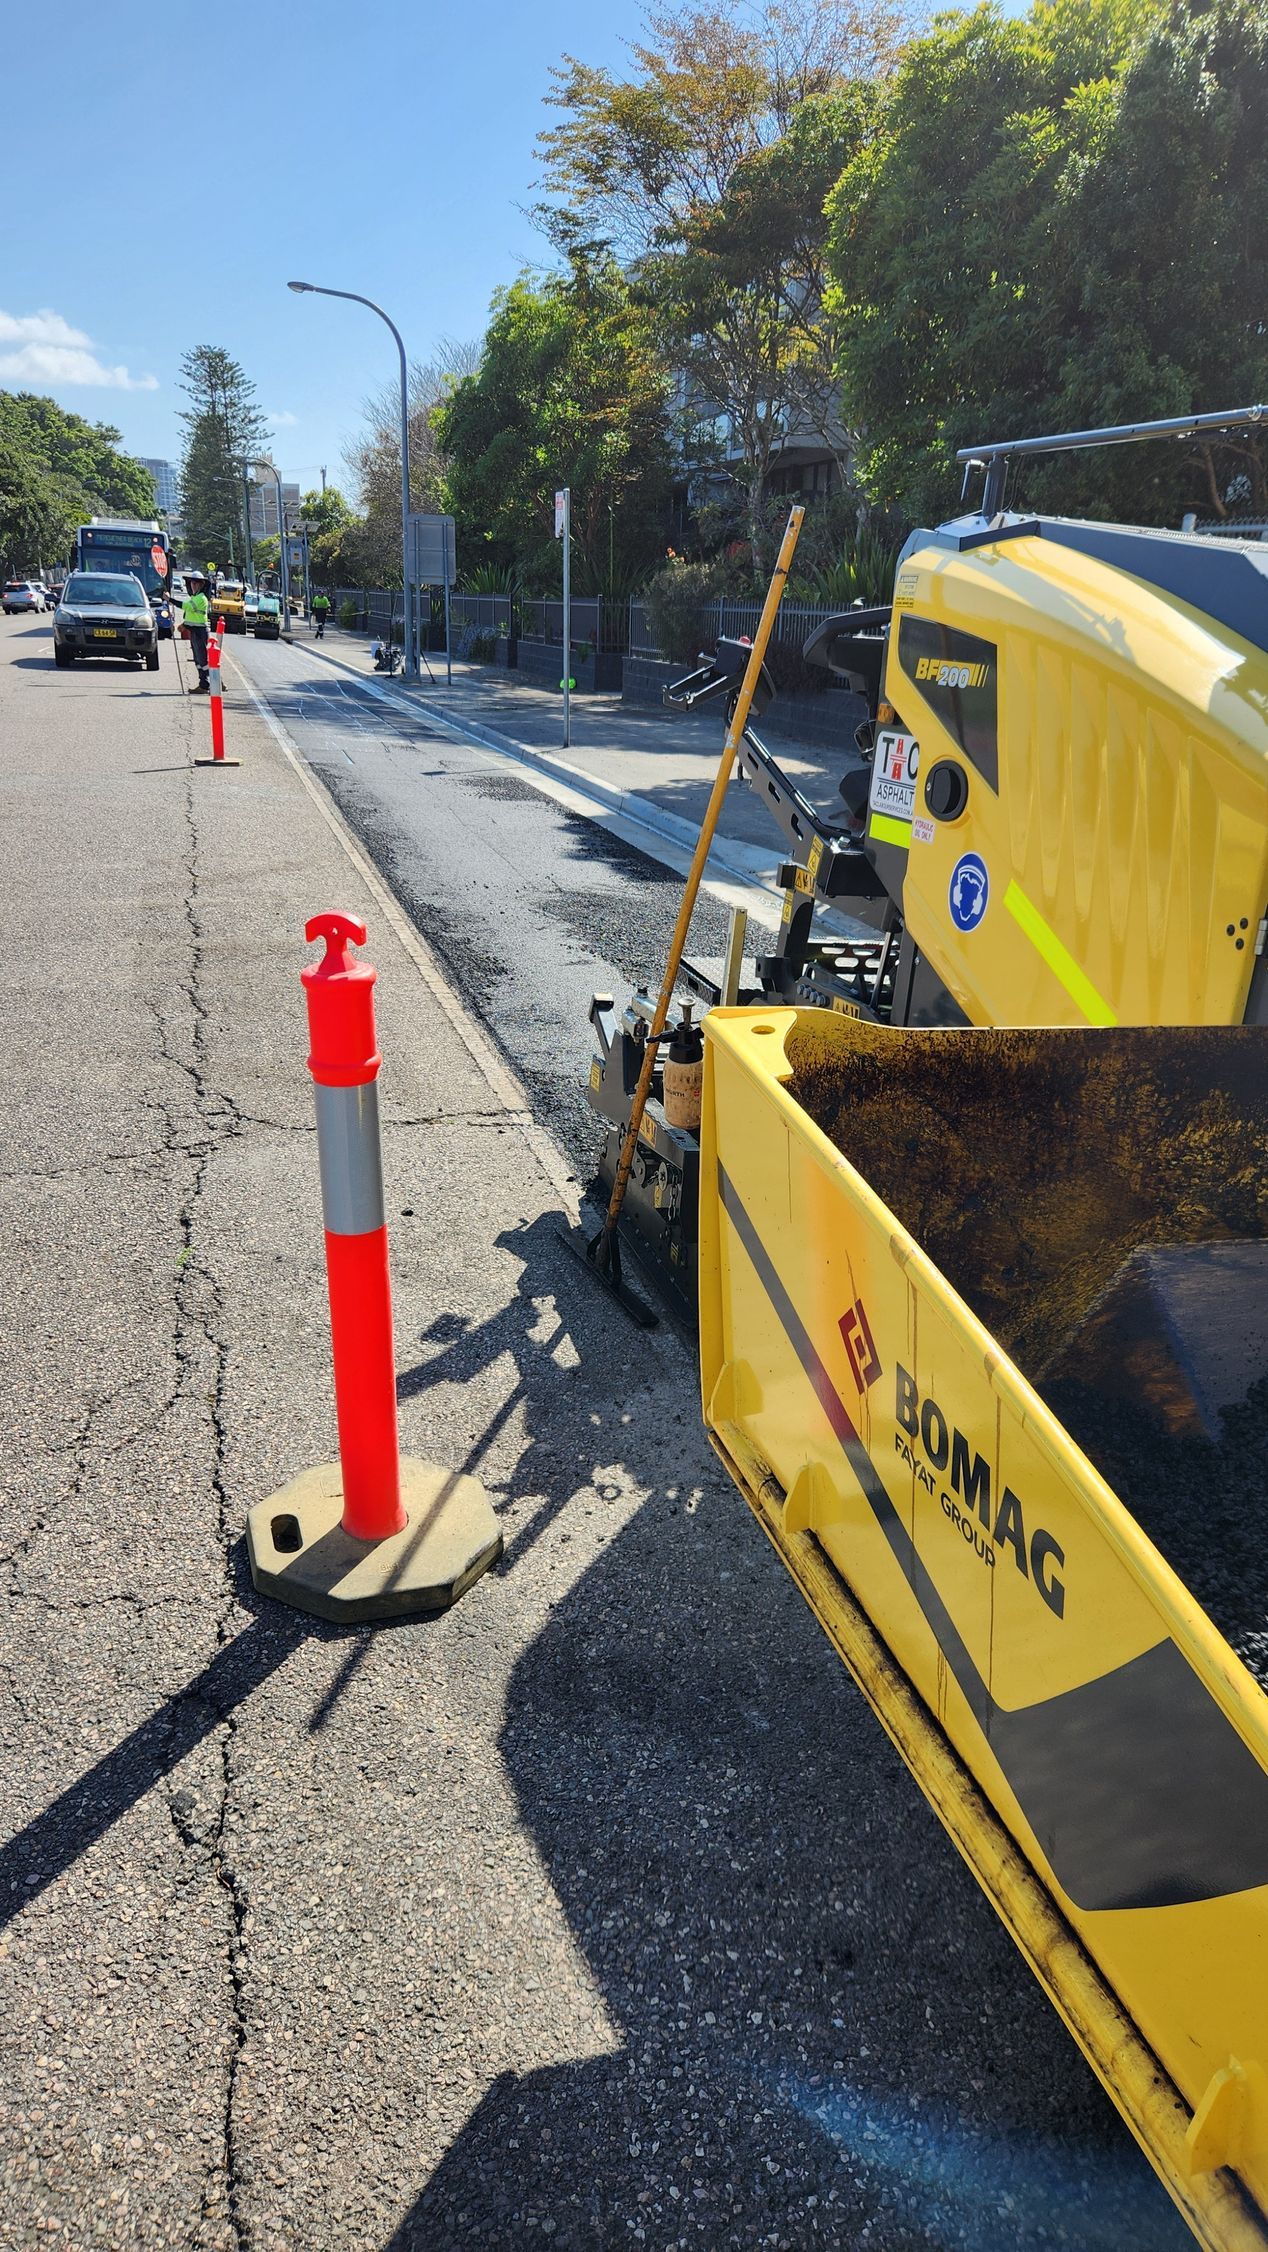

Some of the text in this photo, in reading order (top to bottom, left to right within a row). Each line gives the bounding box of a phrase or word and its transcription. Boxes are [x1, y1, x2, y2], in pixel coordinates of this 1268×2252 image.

[915, 657, 970, 689] BF200
[877, 784, 914, 807] ASPHALT
[895, 1433, 995, 1568] FAYAT GROUP
[896, 1361, 1065, 1620] BOMAG
